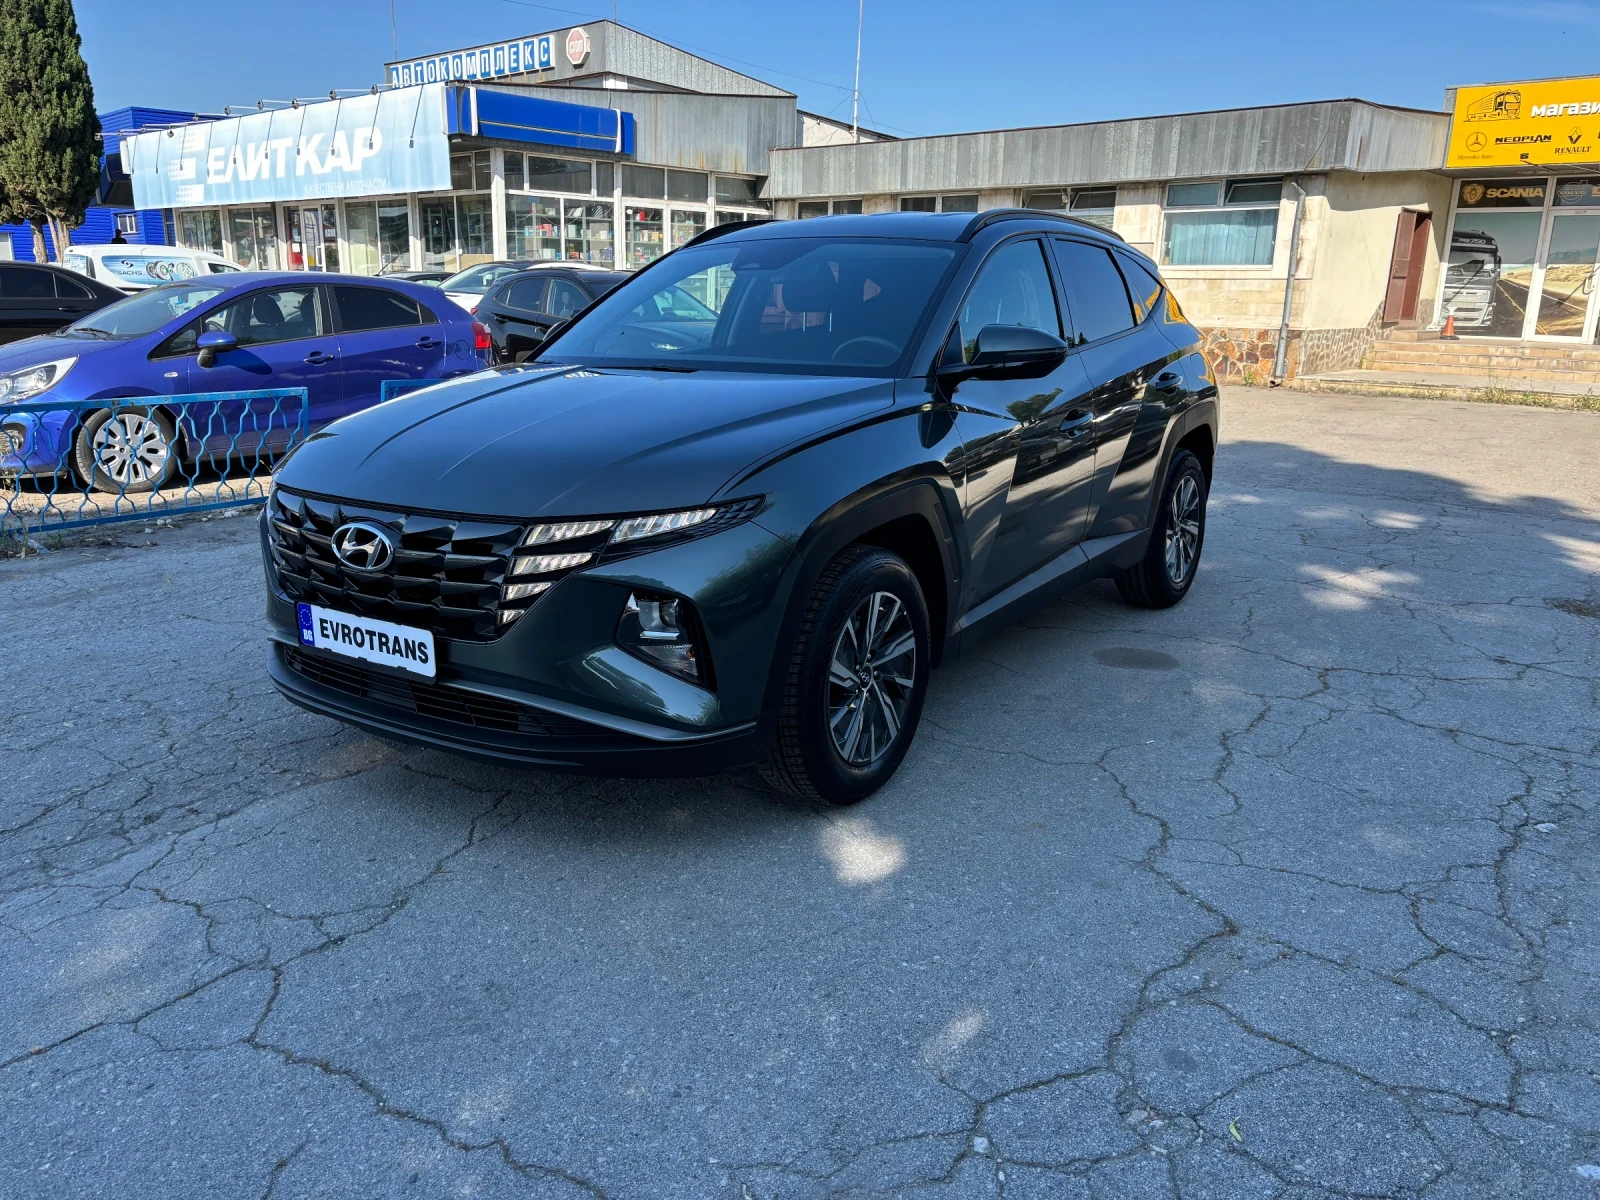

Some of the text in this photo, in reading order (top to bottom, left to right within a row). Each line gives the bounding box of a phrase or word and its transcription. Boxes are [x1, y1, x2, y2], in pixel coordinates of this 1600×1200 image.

[391, 41, 549, 88] АВТОКОМПЛЕКС
[1495, 135, 1552, 144] NEOPLAN
[206, 126, 383, 185] ЕЛИТ КАР
[1554, 146, 1592, 154] RENAULT
[304, 178, 387, 195] КАЧЕСТВЕНИ АВТОЧАСТИ
[1485, 187, 1544, 198] SCANIA
[302, 629, 314, 642] BG
[318, 617, 429, 664] EVROTRANS
